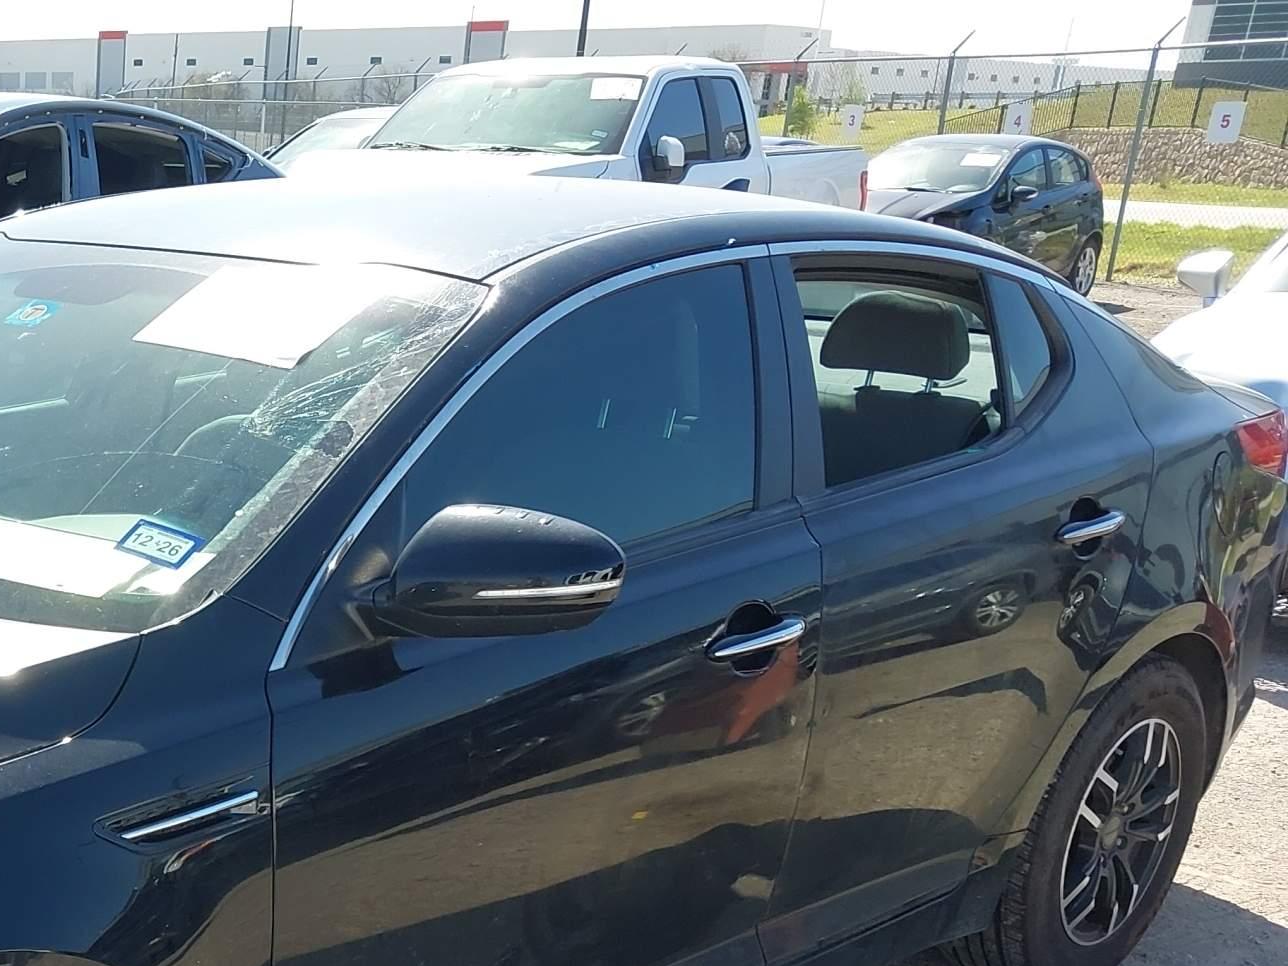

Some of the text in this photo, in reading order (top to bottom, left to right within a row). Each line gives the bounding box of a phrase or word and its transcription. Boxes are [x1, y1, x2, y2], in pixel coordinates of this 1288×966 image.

[848, 114, 856, 127] 3
[1014, 114, 1022, 128] 4
[1220, 114, 1231, 128] 5
